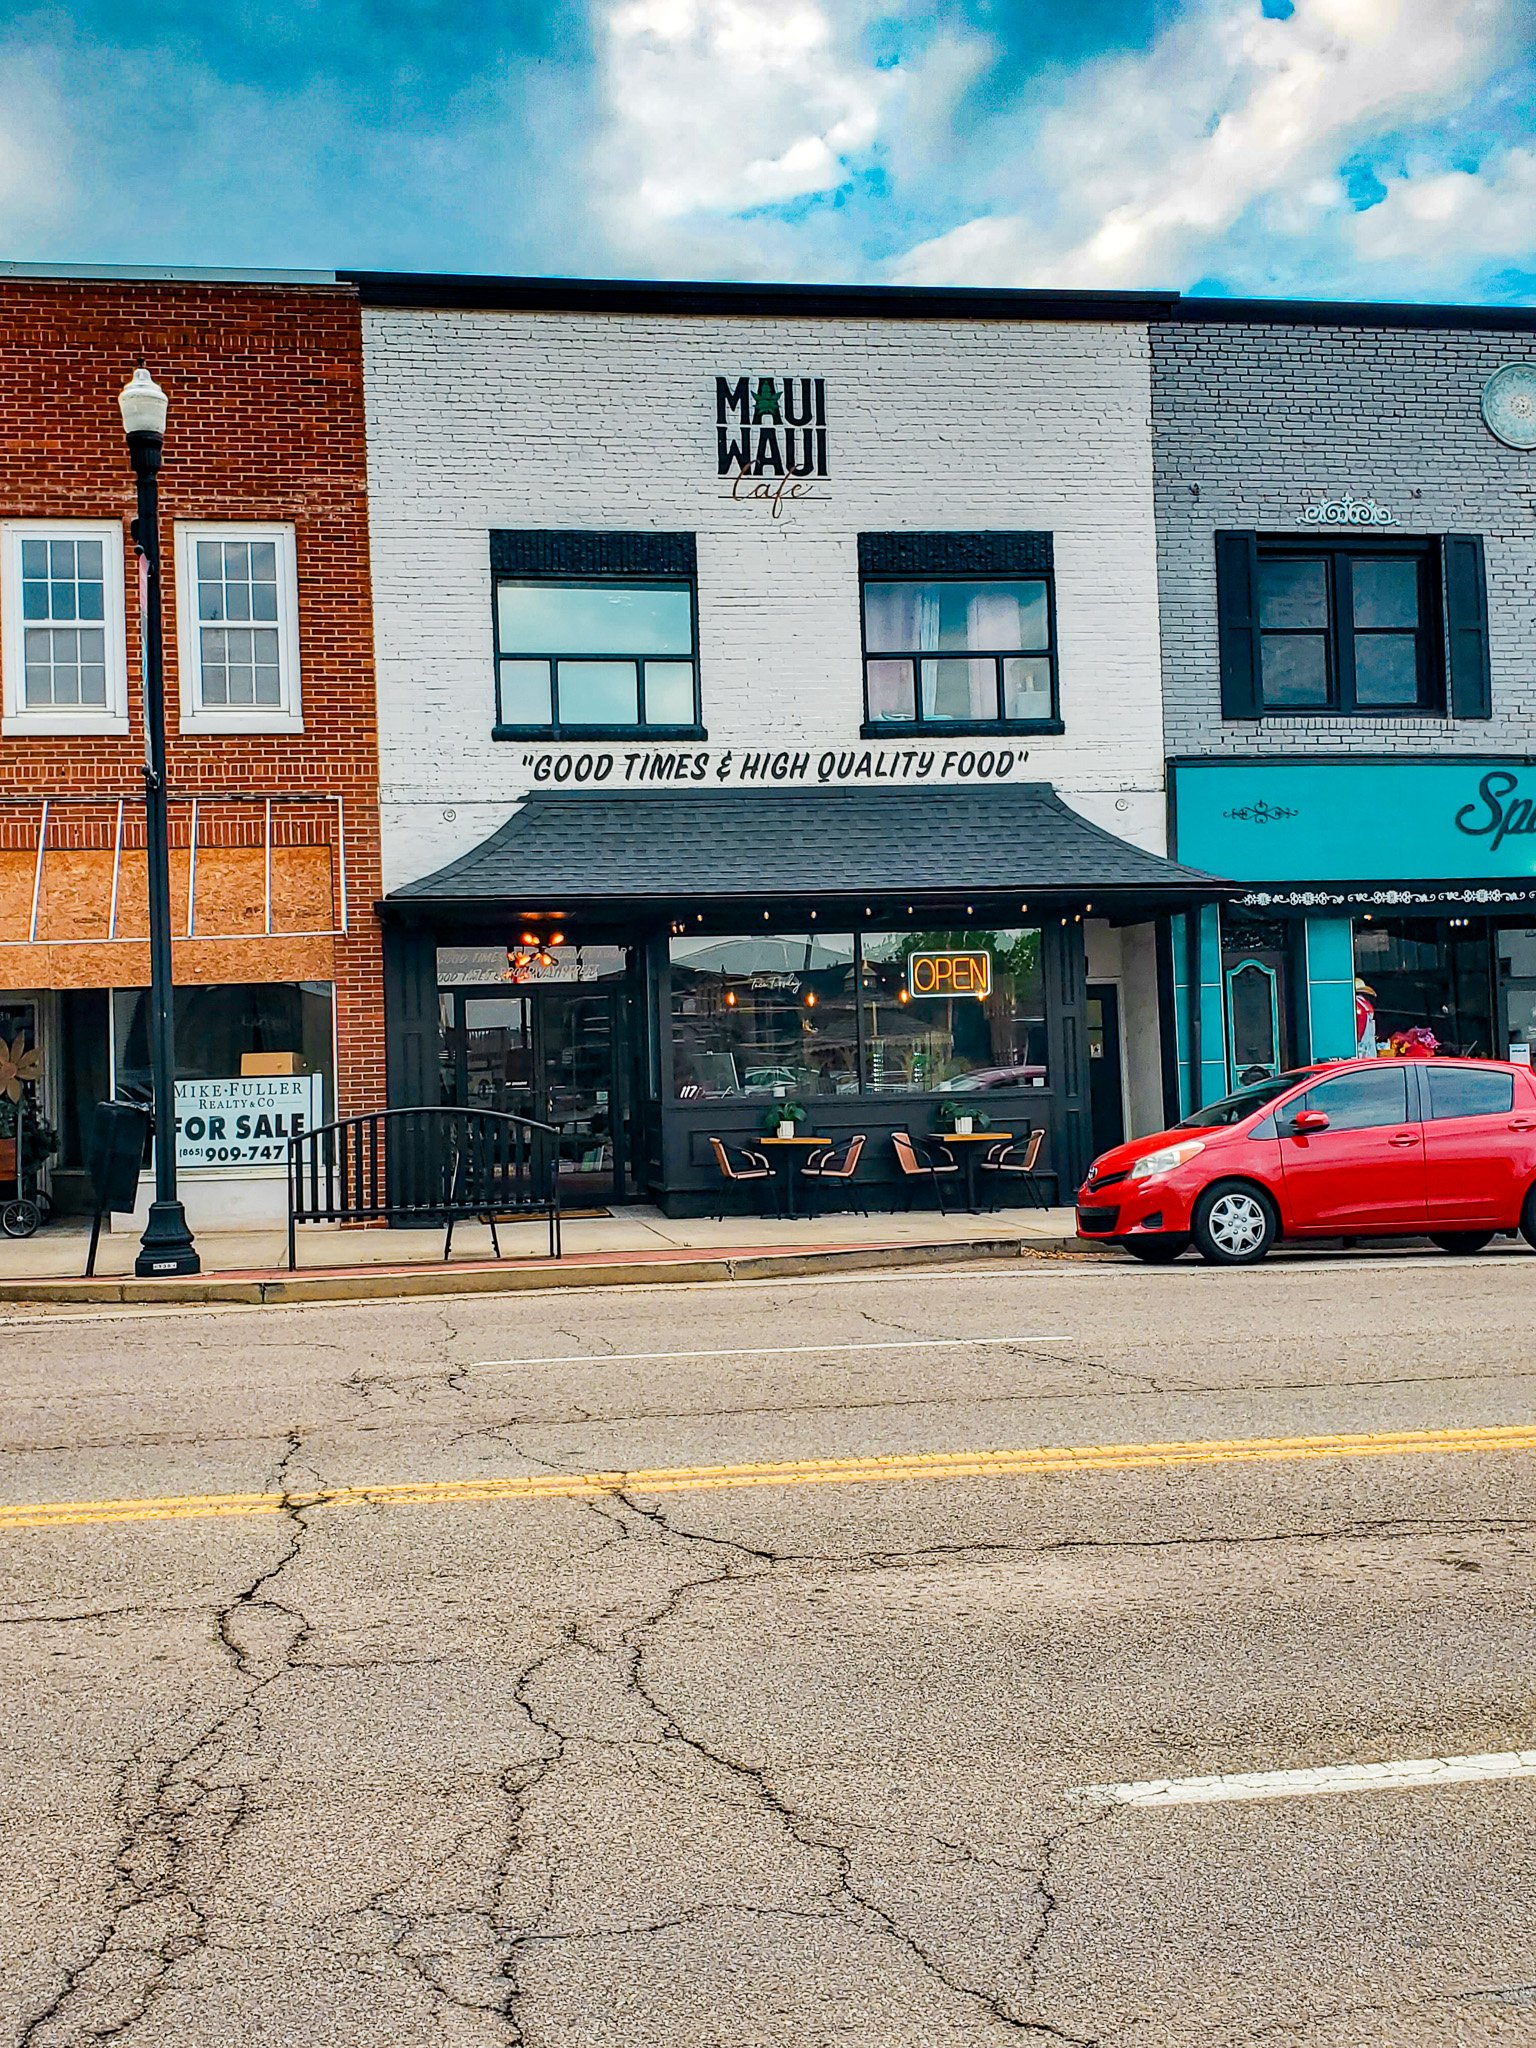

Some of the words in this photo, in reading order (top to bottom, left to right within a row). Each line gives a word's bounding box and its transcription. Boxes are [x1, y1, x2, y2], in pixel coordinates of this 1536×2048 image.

[715, 377, 826, 426] MAUI
[716, 426, 828, 476] WAUI
[522, 754, 614, 782] "GOOD
[625, 752, 710, 781] TIMES
[716, 750, 732, 782] &
[739, 751, 810, 780] HIGH
[817, 751, 935, 783] QUALITY
[941, 750, 1030, 778] FOOD"
[914, 956, 987, 991] OPEN
[235, 1113, 305, 1139] SALE
[205, 1145, 294, 1162] 909-747
